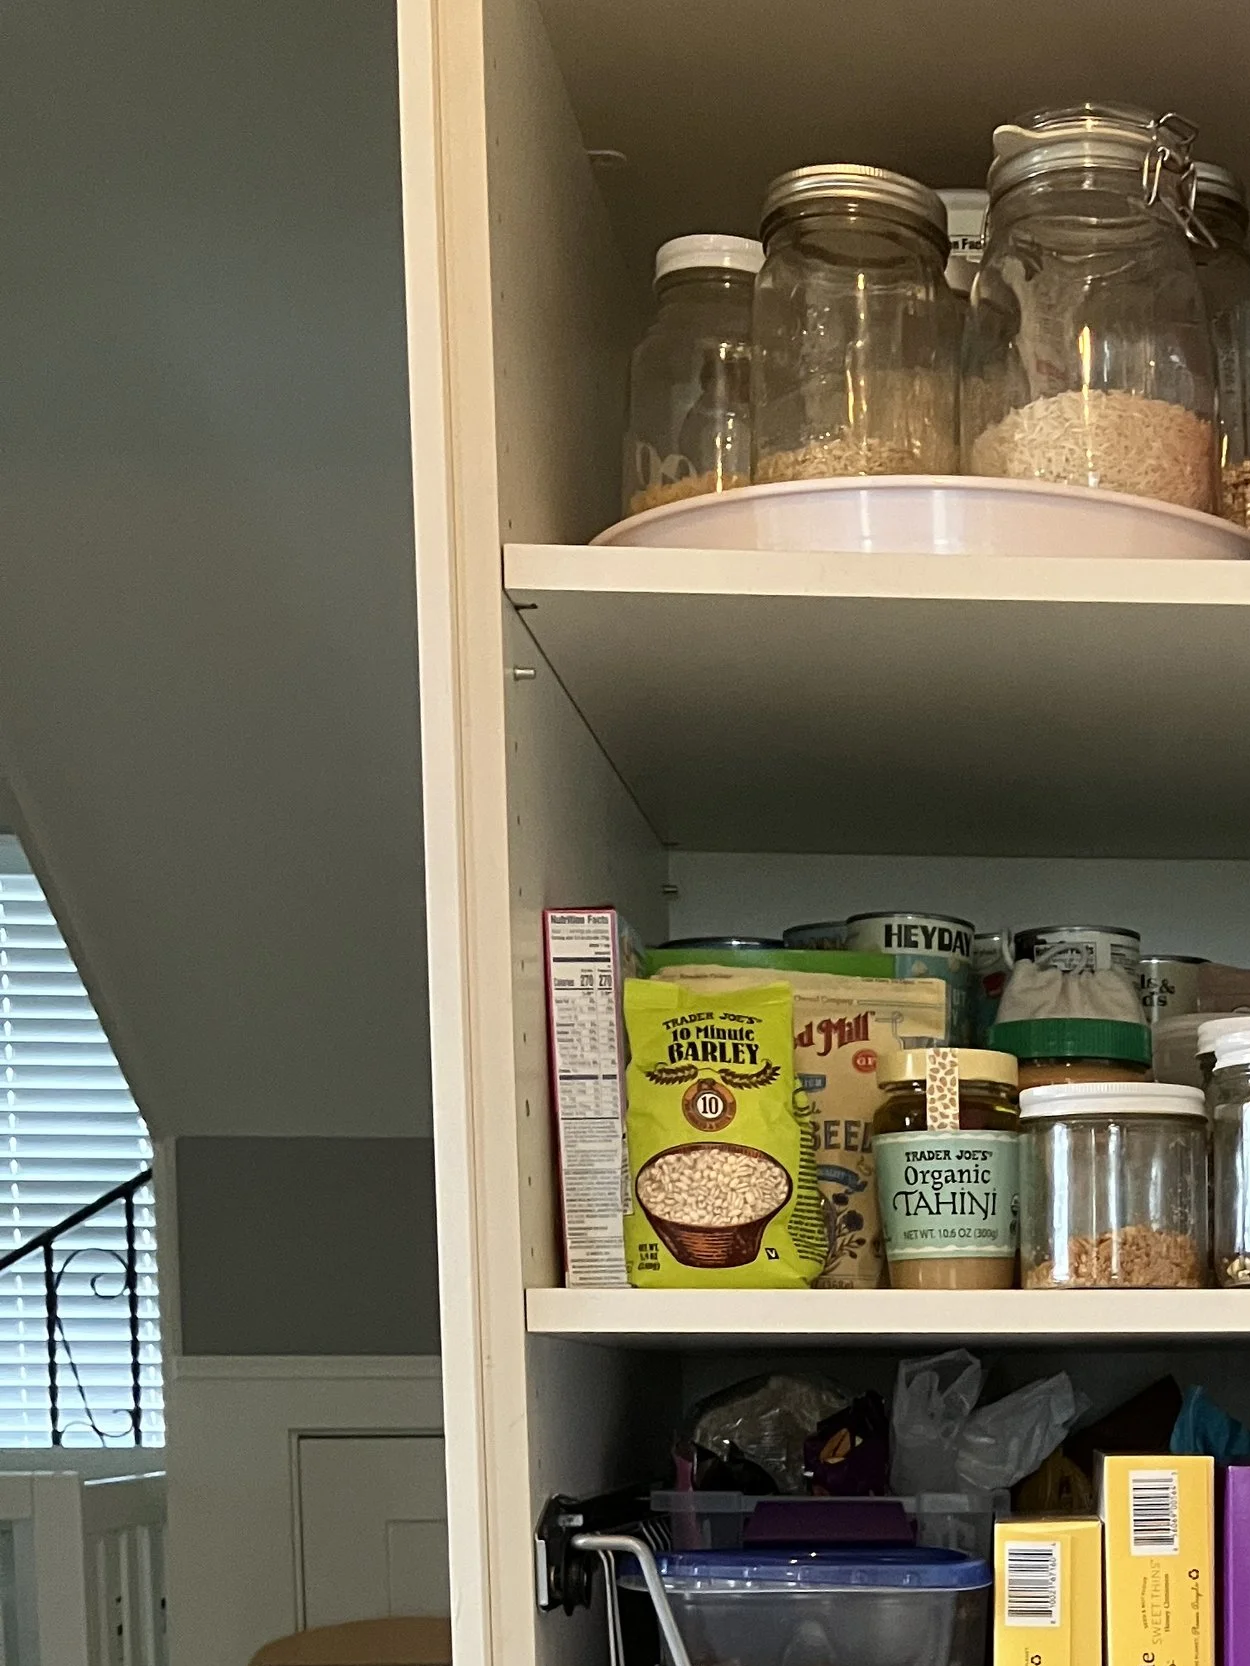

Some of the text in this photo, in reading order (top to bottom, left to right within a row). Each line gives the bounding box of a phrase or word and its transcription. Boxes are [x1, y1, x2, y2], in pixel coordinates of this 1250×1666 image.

[551, 915, 609, 925] Nutrition Facts
[884, 924, 972, 957] HEYDAY
[580, 974, 594, 987] 270
[599, 974, 613, 987] 270
[662, 1012, 760, 1030] TRADER JOE'S
[672, 1025, 755, 1042] 10 Minute
[817, 1011, 870, 1056] Mill
[668, 1041, 759, 1064] BARLEY
[702, 1096, 719, 1114] 10
[905, 1150, 989, 1162] TRADER JOE'S
[904, 1164, 991, 1191] Organic
[892, 1187, 998, 1220] TAHINI
[903, 1229, 919, 1240] NET
[938, 1228, 956, 1239] 10.6
[957, 1228, 972, 1239] OZ
[974, 1228, 998, 1241] (300g)
[1150, 1562, 1163, 1645] SWEET THINS
